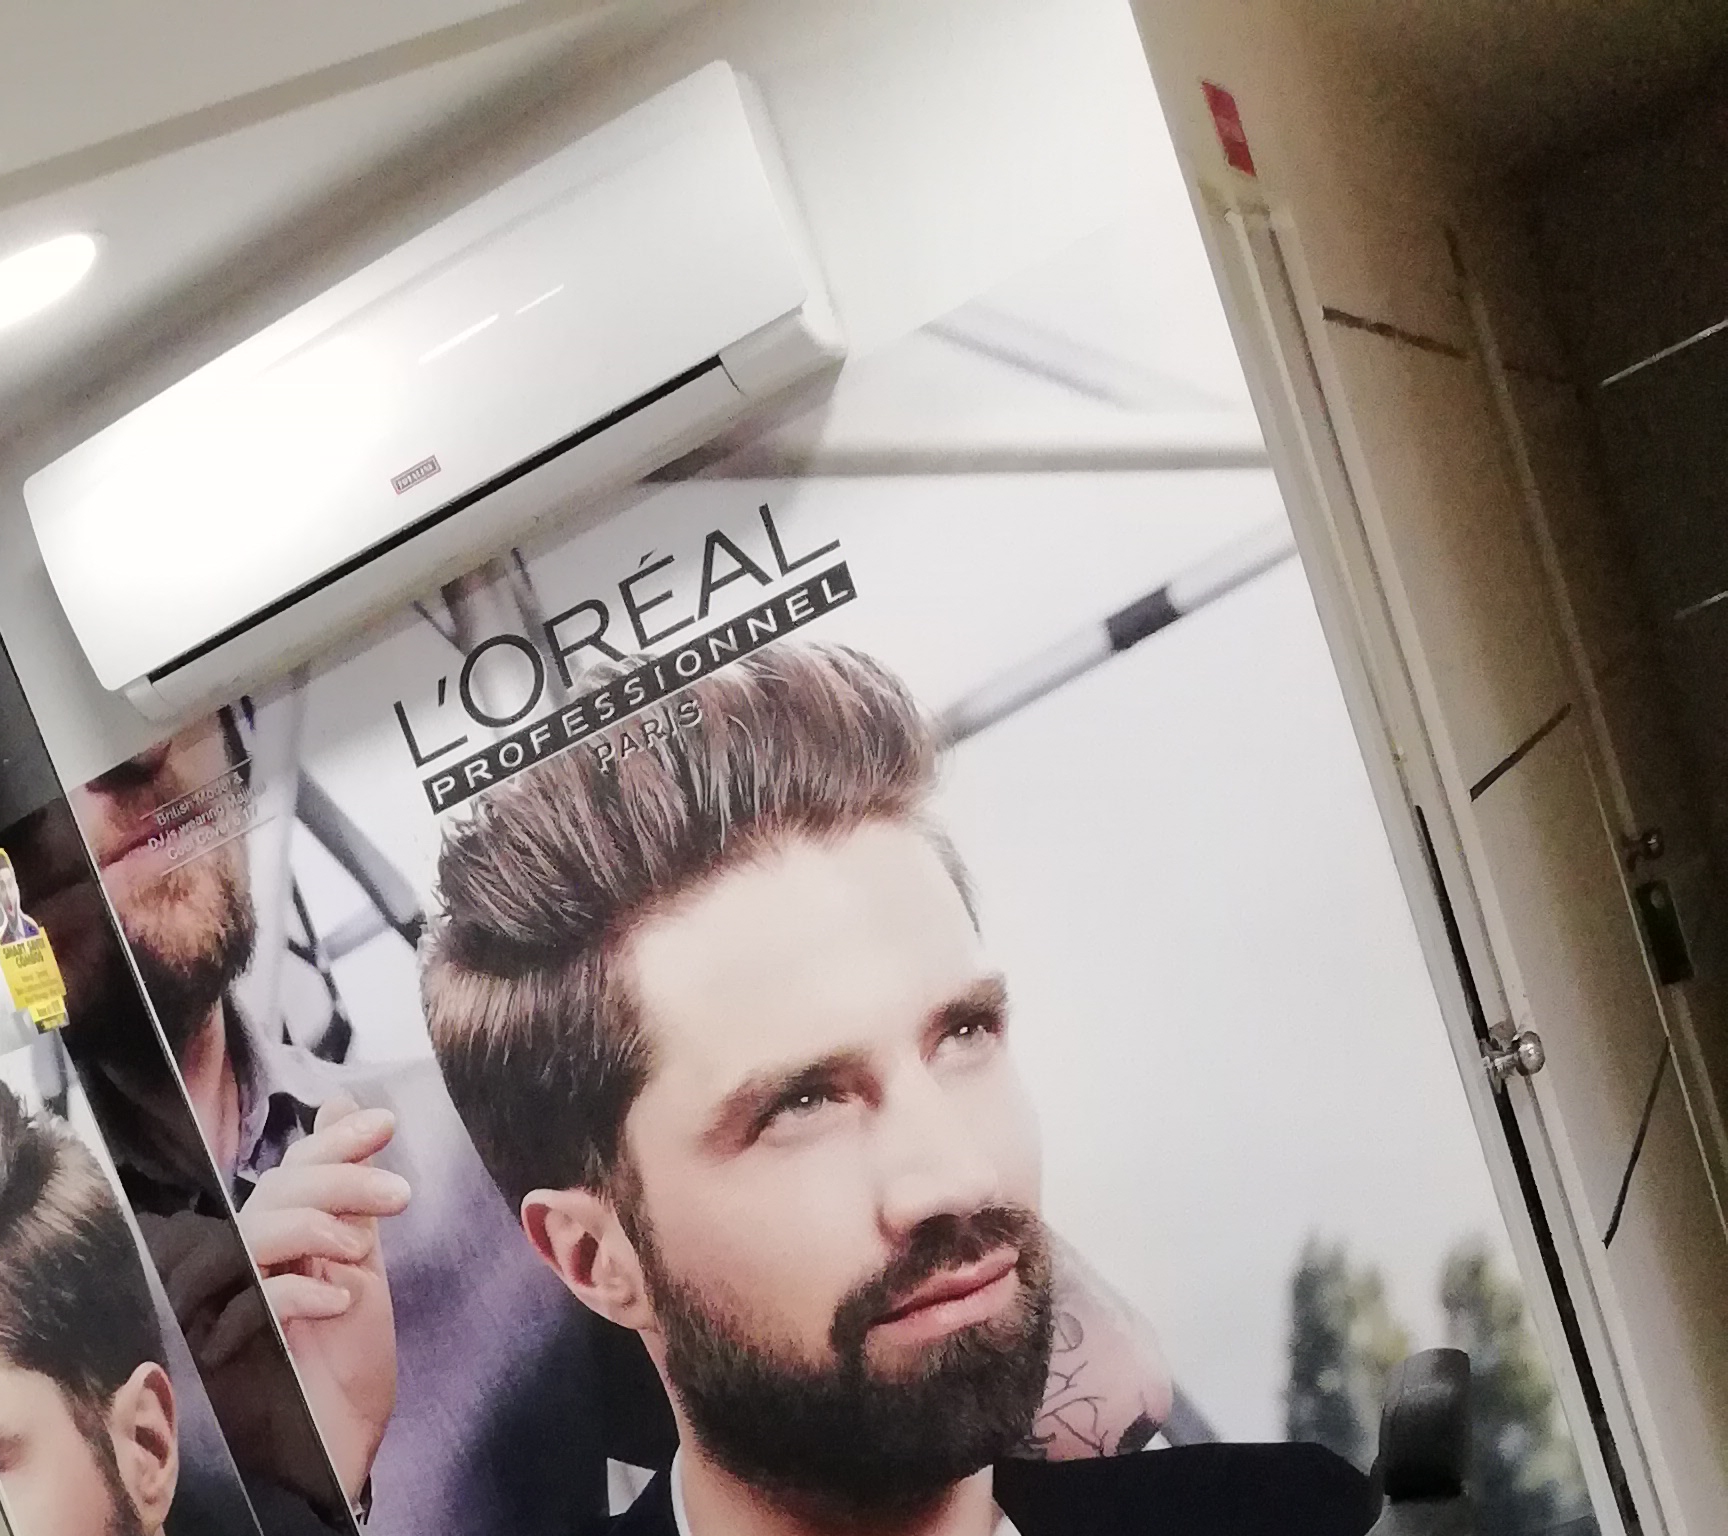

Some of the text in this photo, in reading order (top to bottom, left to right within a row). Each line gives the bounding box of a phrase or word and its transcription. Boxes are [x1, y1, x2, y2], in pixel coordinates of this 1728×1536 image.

[393, 503, 842, 767] L'ORÉAL
[430, 578, 852, 806] PROFESSIONNEL
[596, 701, 702, 776] PARIS
